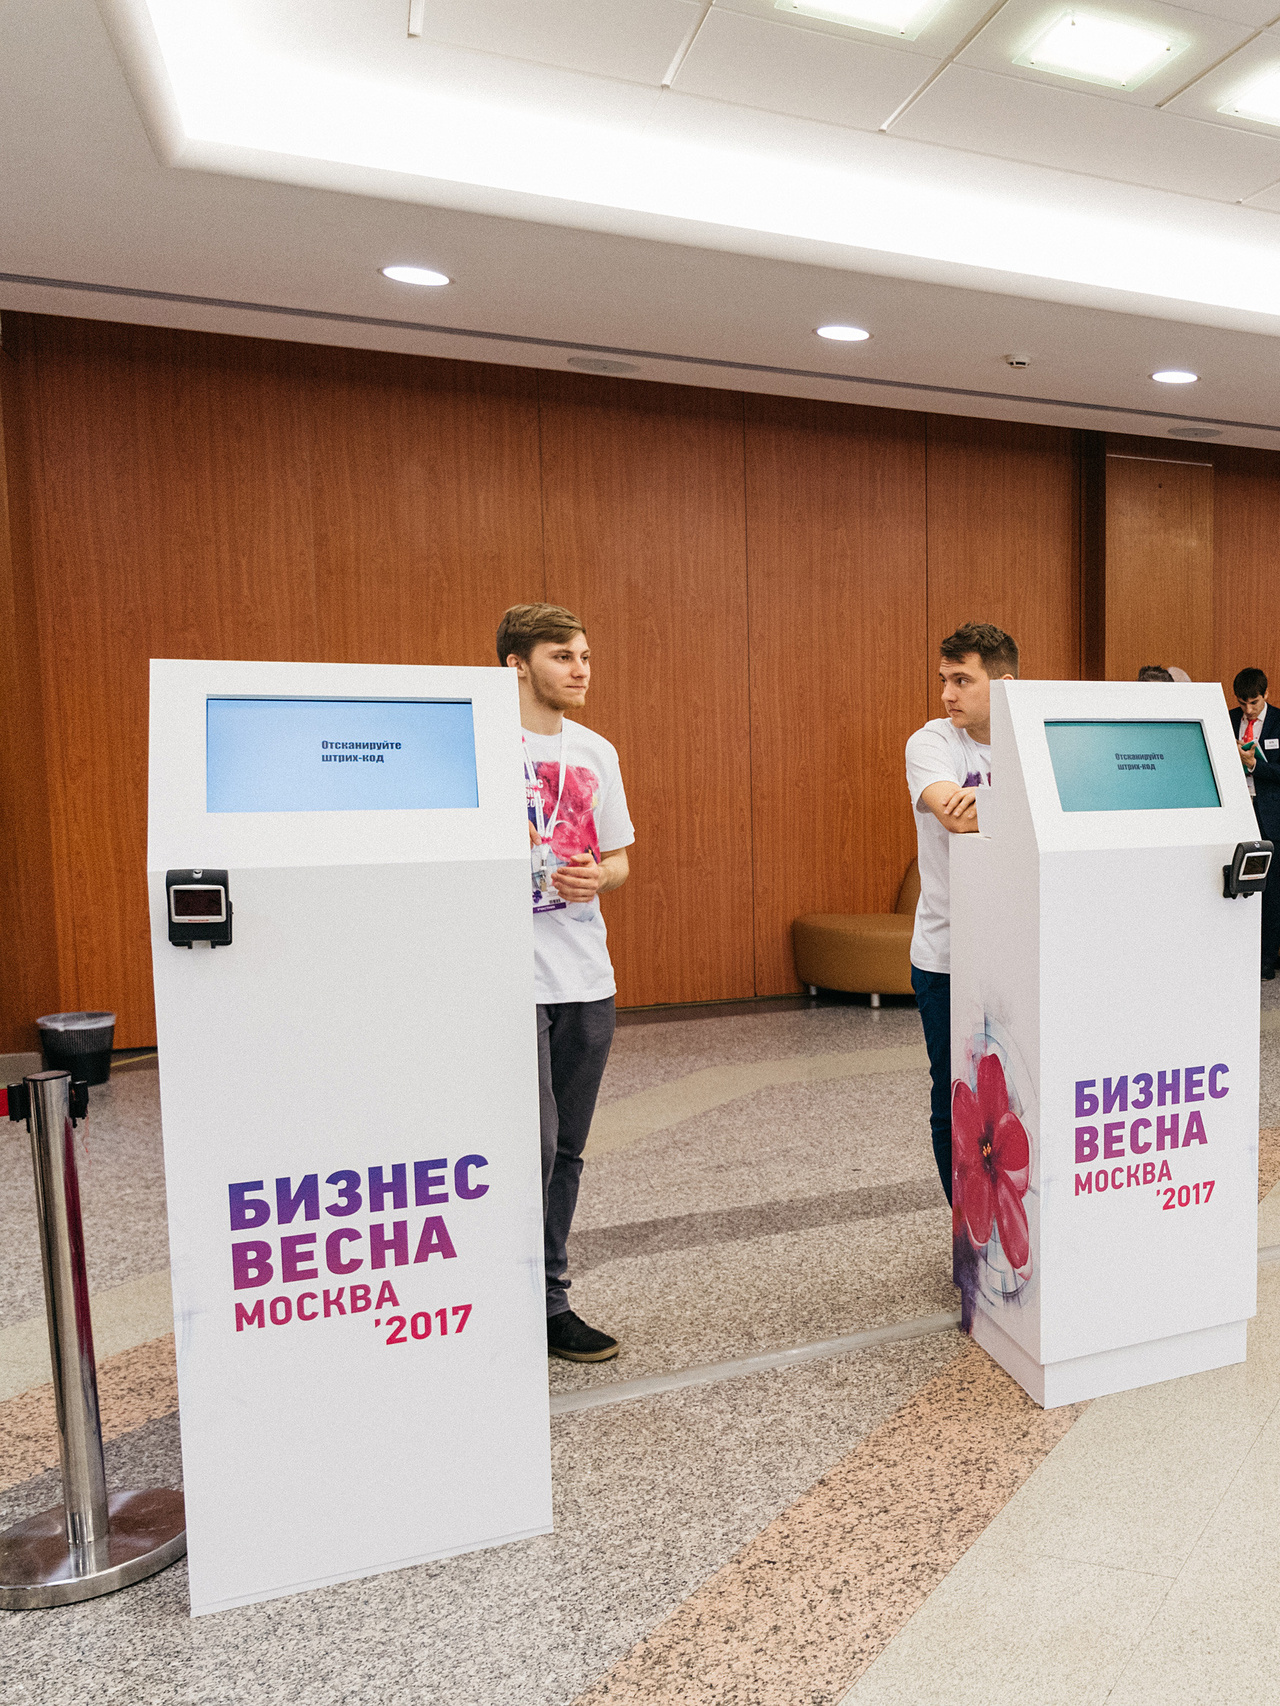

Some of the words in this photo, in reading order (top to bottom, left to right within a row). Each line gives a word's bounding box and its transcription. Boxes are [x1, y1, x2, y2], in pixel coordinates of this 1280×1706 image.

[321, 740, 402, 750] Отсканируйте
[321, 754, 385, 763] штрих-код
[1115, 752, 1164, 761] Отсканируйте
[1117, 763, 1156, 771] штрих-код
[1075, 1063, 1230, 1118] БИЗНЕС
[1074, 1110, 1208, 1164] ВЕСНА
[228, 1154, 490, 1231] БИЗНЕС
[1074, 1159, 1172, 1197] МОСКВА
[1156, 1180, 1216, 1211] '2017
[231, 1215, 458, 1291] ВЕСНА
[234, 1279, 401, 1332] МОСКВА
[374, 1303, 473, 1346] '2017
